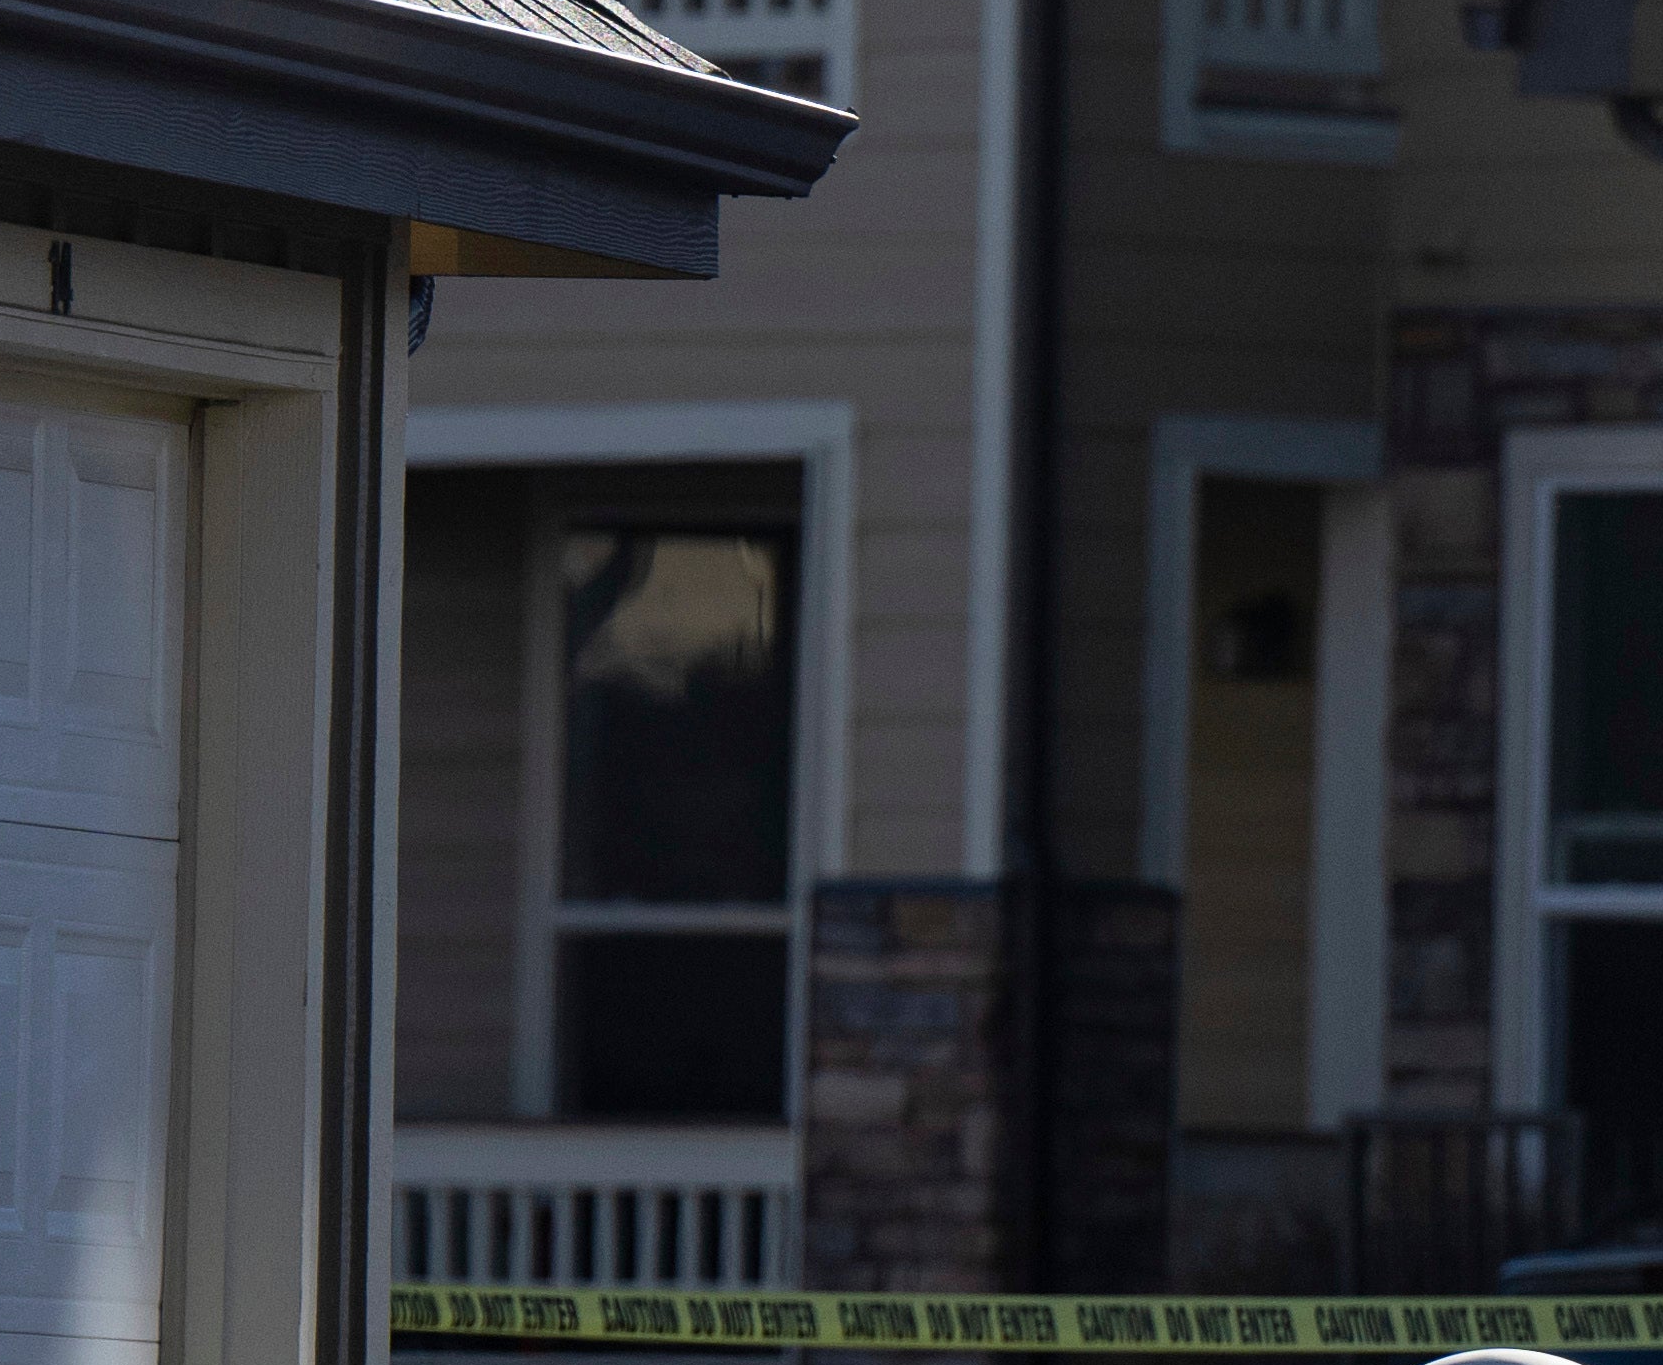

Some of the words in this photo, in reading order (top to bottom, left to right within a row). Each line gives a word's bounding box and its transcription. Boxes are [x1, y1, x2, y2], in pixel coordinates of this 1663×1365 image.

[448, 1292, 477, 1328] DO
[479, 1293, 516, 1330] NOT
[518, 1295, 580, 1331] ENTER
[598, 1296, 680, 1334] CAUTION
[686, 1298, 716, 1335] DO
[717, 1299, 756, 1336] NOT
[758, 1300, 818, 1338] ENTER
[839, 1301, 921, 1342] CAUTION
[926, 1302, 955, 1342] DO
[957, 1303, 993, 1343] NOT
[997, 1303, 1058, 1344] ENTER
[1076, 1303, 1157, 1344] CAUTION
[1164, 1304, 1192, 1344] DO
[1194, 1304, 1236, 1344] NOT
[1238, 1305, 1297, 1344] ENTER
[1314, 1305, 1396, 1344] CAUTION
[1402, 1305, 1434, 1343] DO
[1435, 1305, 1473, 1343] NOT
[1475, 1305, 1536, 1343] ENTER
[1554, 1303, 1635, 1342] CAUTION
